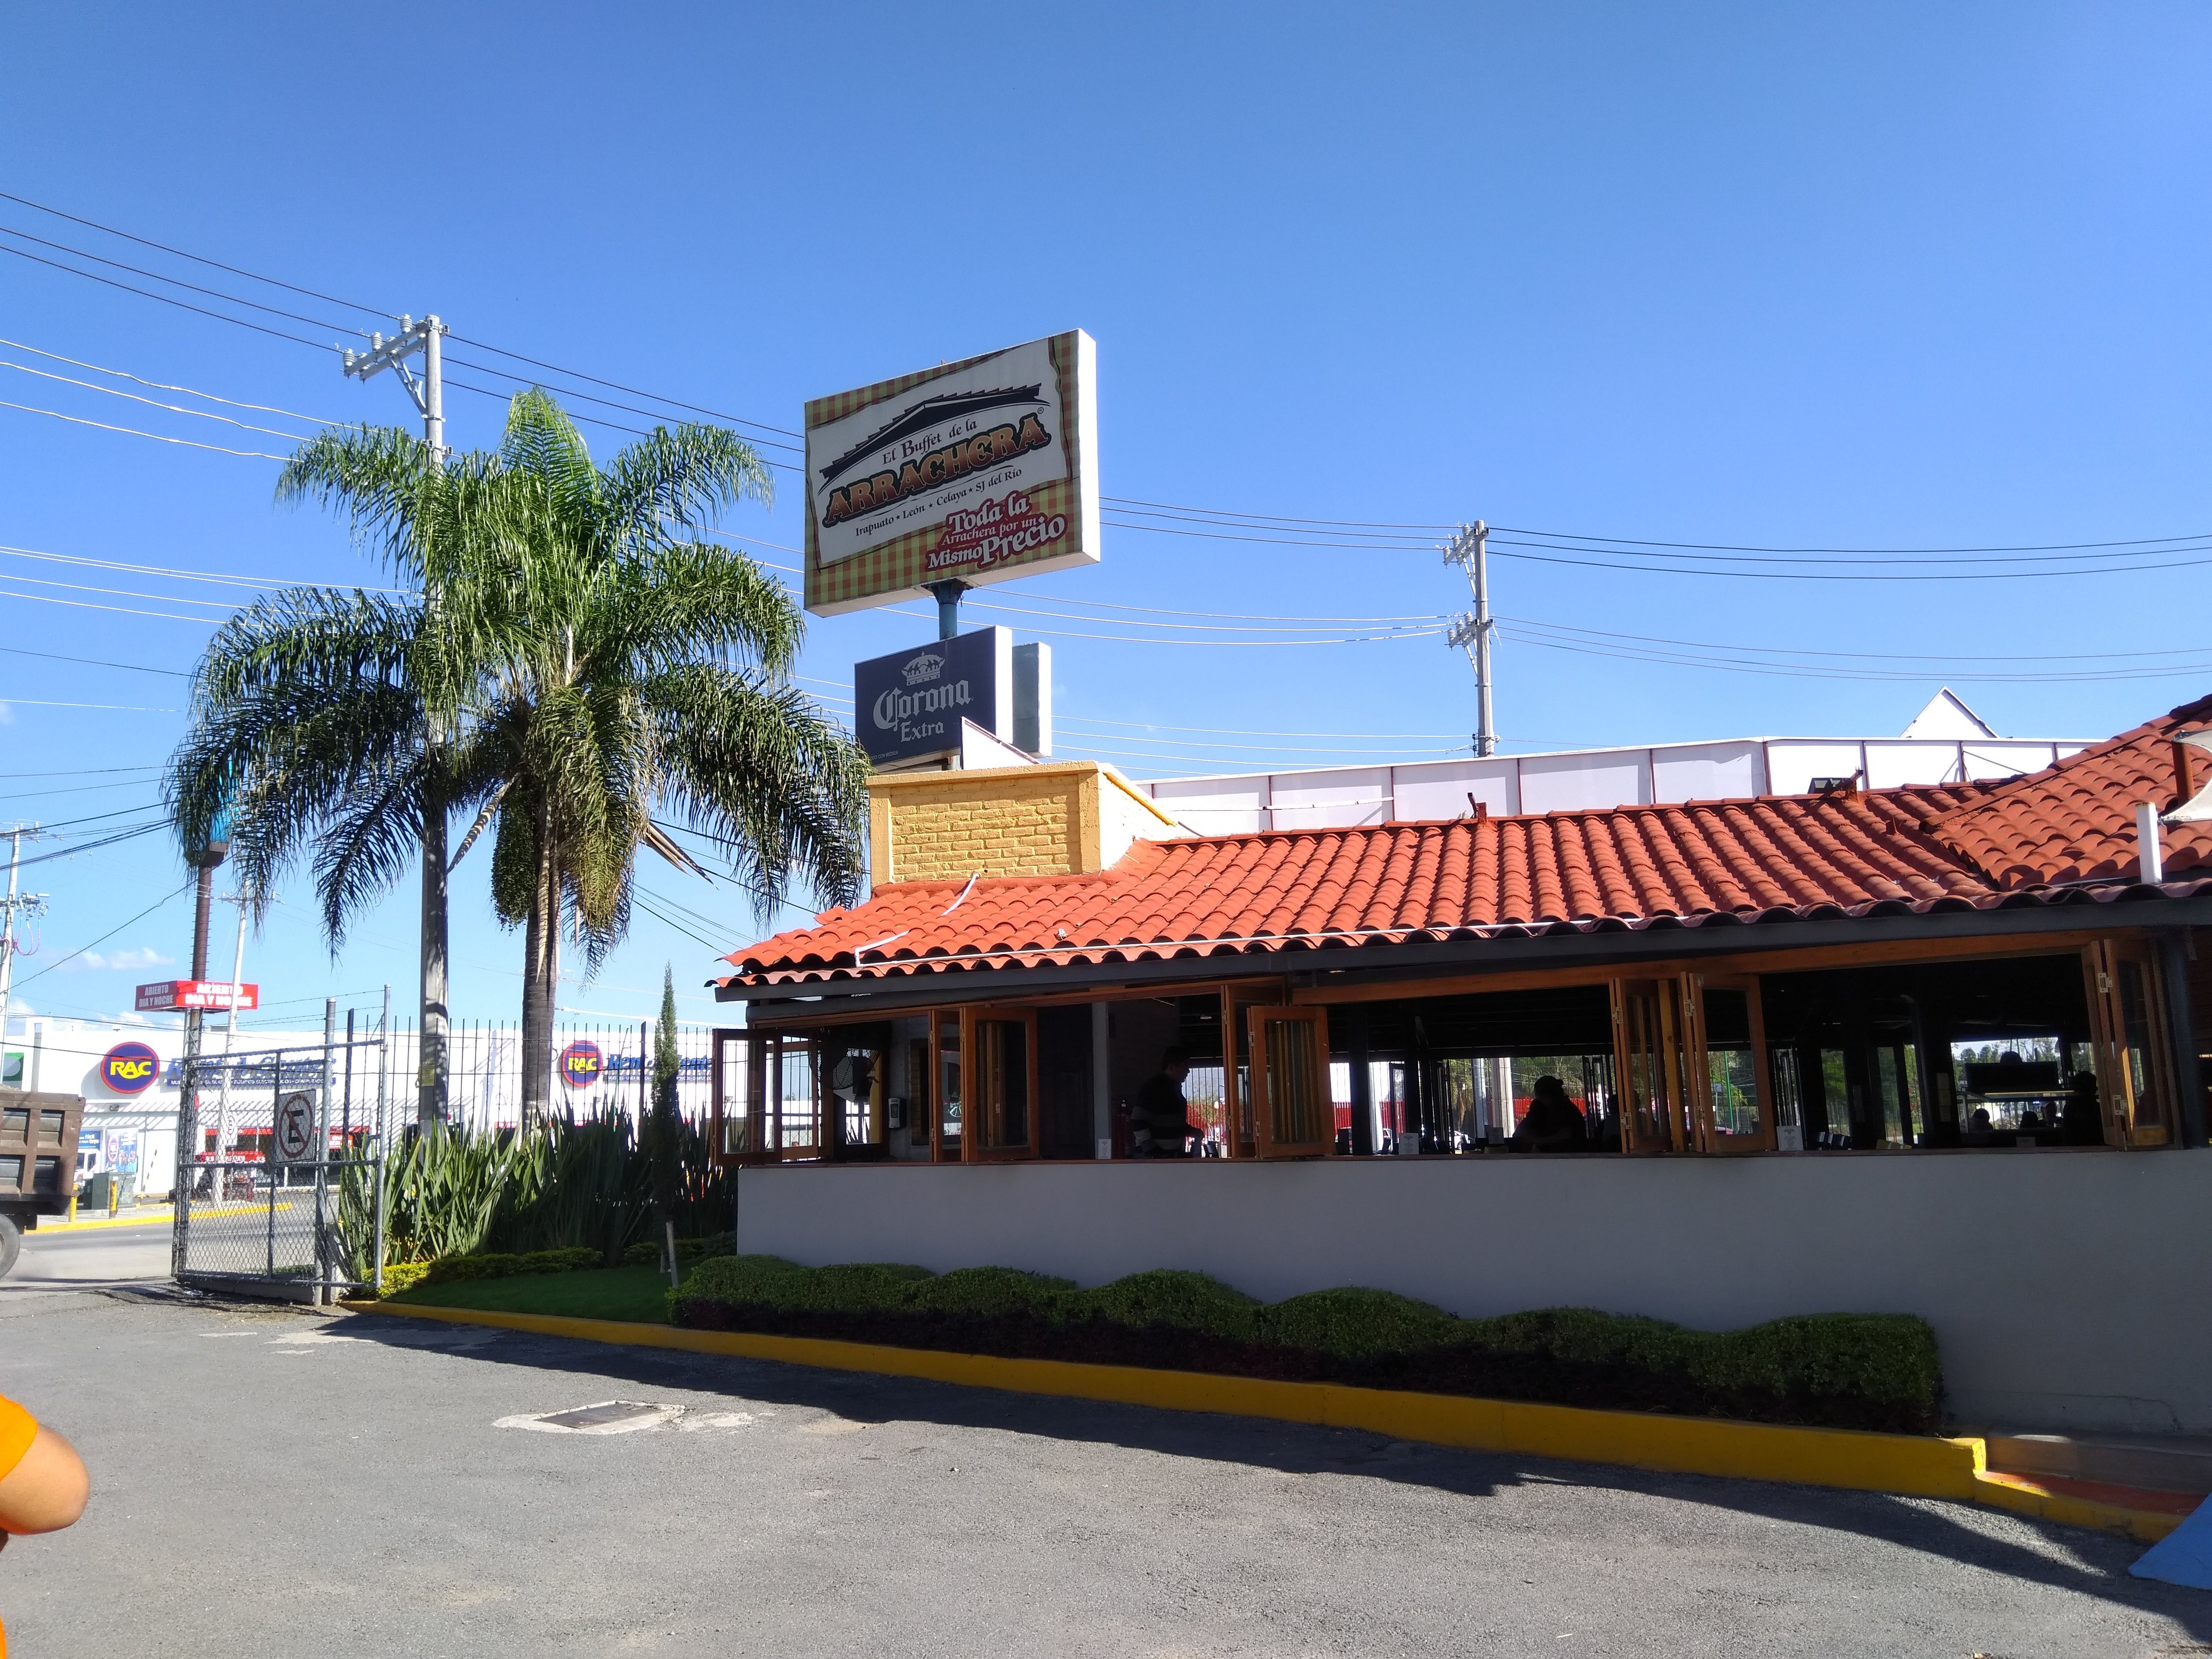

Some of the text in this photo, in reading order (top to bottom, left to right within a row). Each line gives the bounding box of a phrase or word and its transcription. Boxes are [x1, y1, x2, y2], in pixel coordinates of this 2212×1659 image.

[882, 419, 978, 465] El Buffet de la
[825, 415, 1048, 524] ARRACHERA
[855, 469, 1022, 537] Irapuato León Celaya SJ del Río
[949, 493, 1029, 534] Toda la
[928, 516, 1066, 569] Mismo Precio
[941, 517, 1038, 546] Arrachera por un
[873, 679, 972, 732] Corona
[901, 721, 944, 743] Extra
[144, 984, 169, 996] ABIERTO
[149, 997, 154, 1006] Y
[154, 995, 174, 1006] NOCHE
[206, 995, 215, 1005] Y
[215, 995, 252, 1007] NOHE
[110, 1061, 152, 1079] RAC
[568, 1057, 597, 1074] RAC
